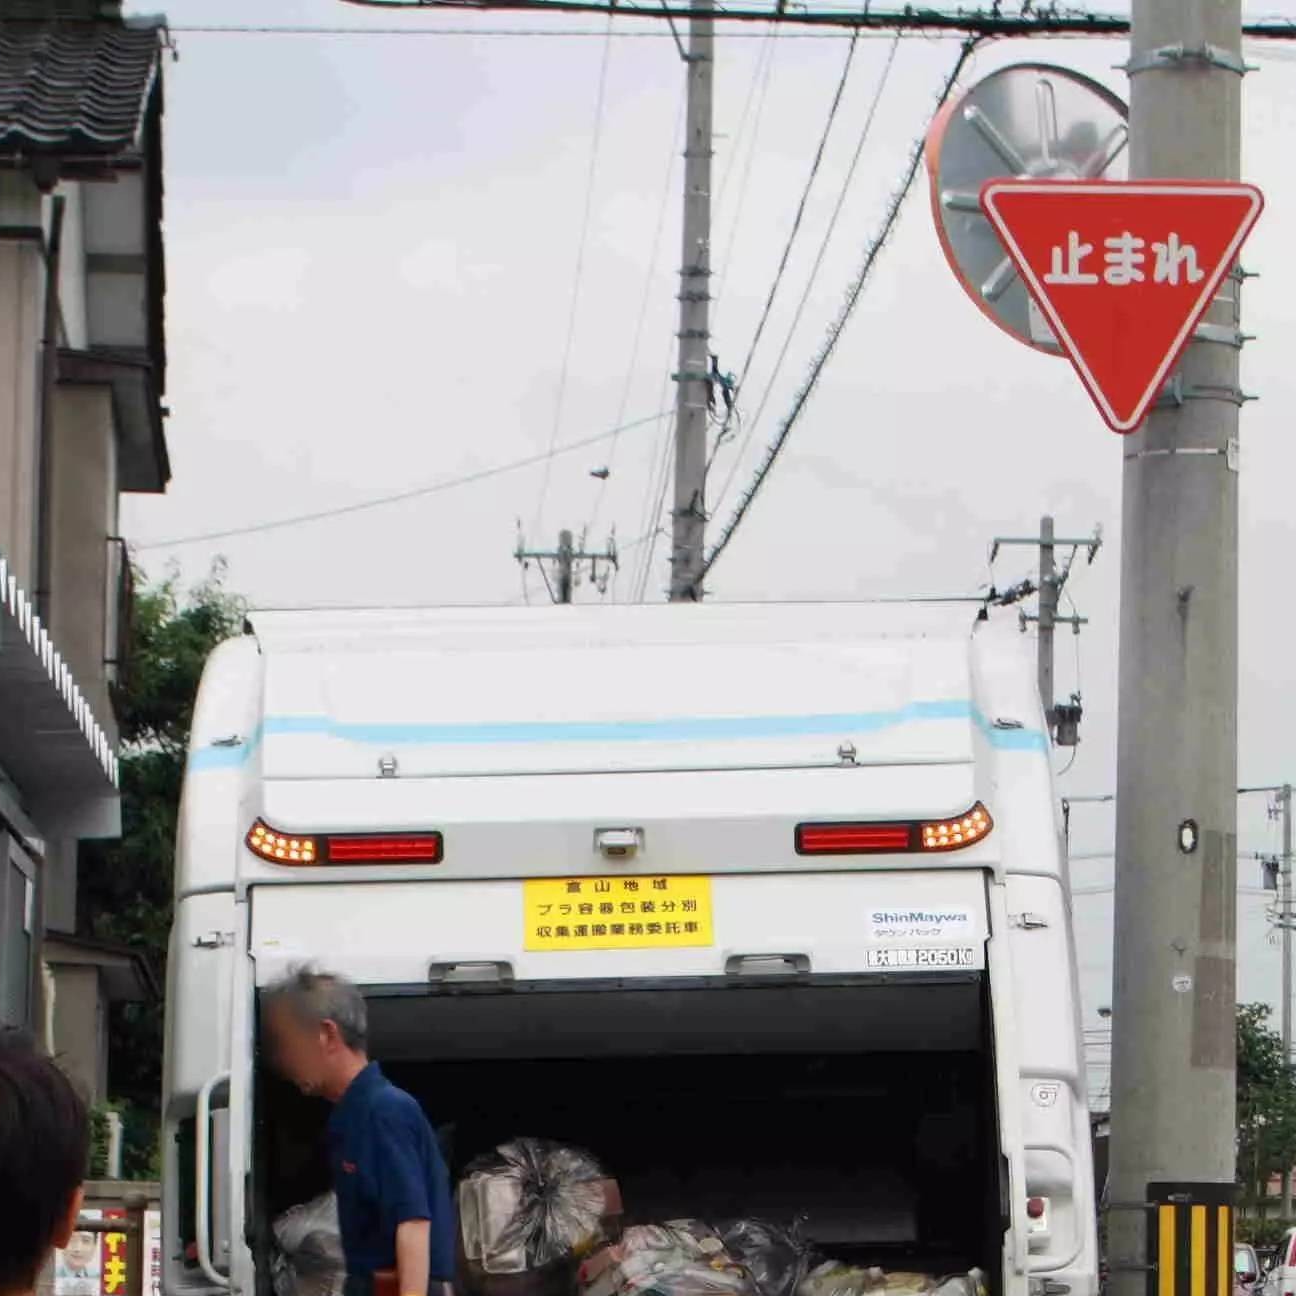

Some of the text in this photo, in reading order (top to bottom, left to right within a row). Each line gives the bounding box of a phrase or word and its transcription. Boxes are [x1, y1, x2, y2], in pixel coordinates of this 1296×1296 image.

[1044, 230, 1204, 286] 止まれ
[566, 879, 668, 894] 富山地域
[536, 898, 697, 916] プラ容器包装分別
[871, 912, 968, 924] ShinMaywa
[536, 921, 699, 938] 収集運搬業務委託車
